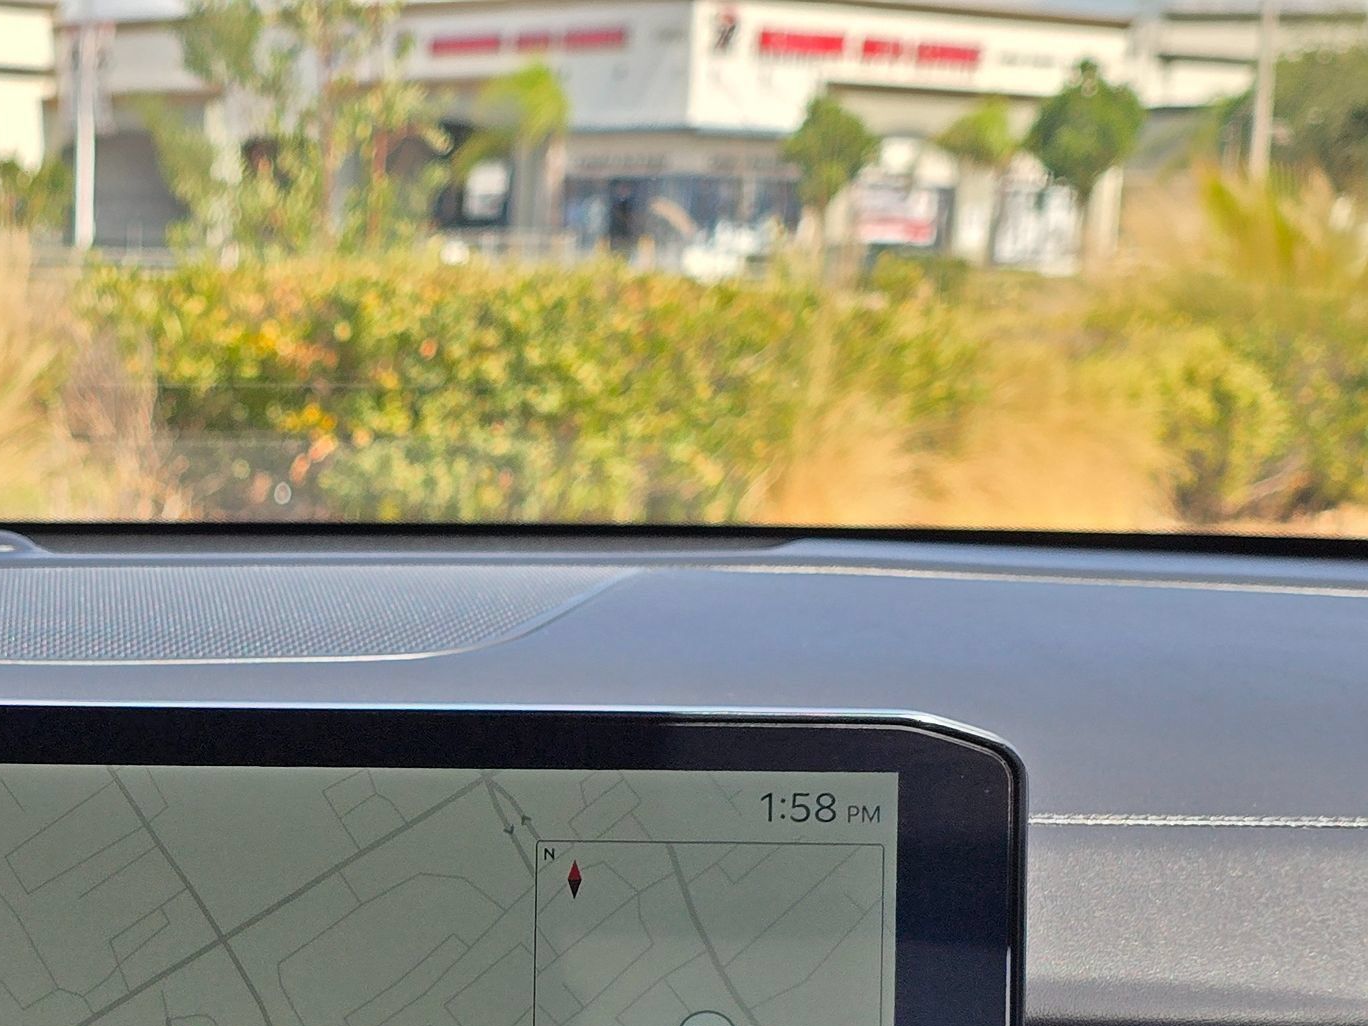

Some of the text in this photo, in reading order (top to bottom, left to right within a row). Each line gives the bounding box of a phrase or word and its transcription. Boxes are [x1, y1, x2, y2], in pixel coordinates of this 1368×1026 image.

[759, 791, 882, 825] 1:58 PM
[543, 847, 556, 862] N
